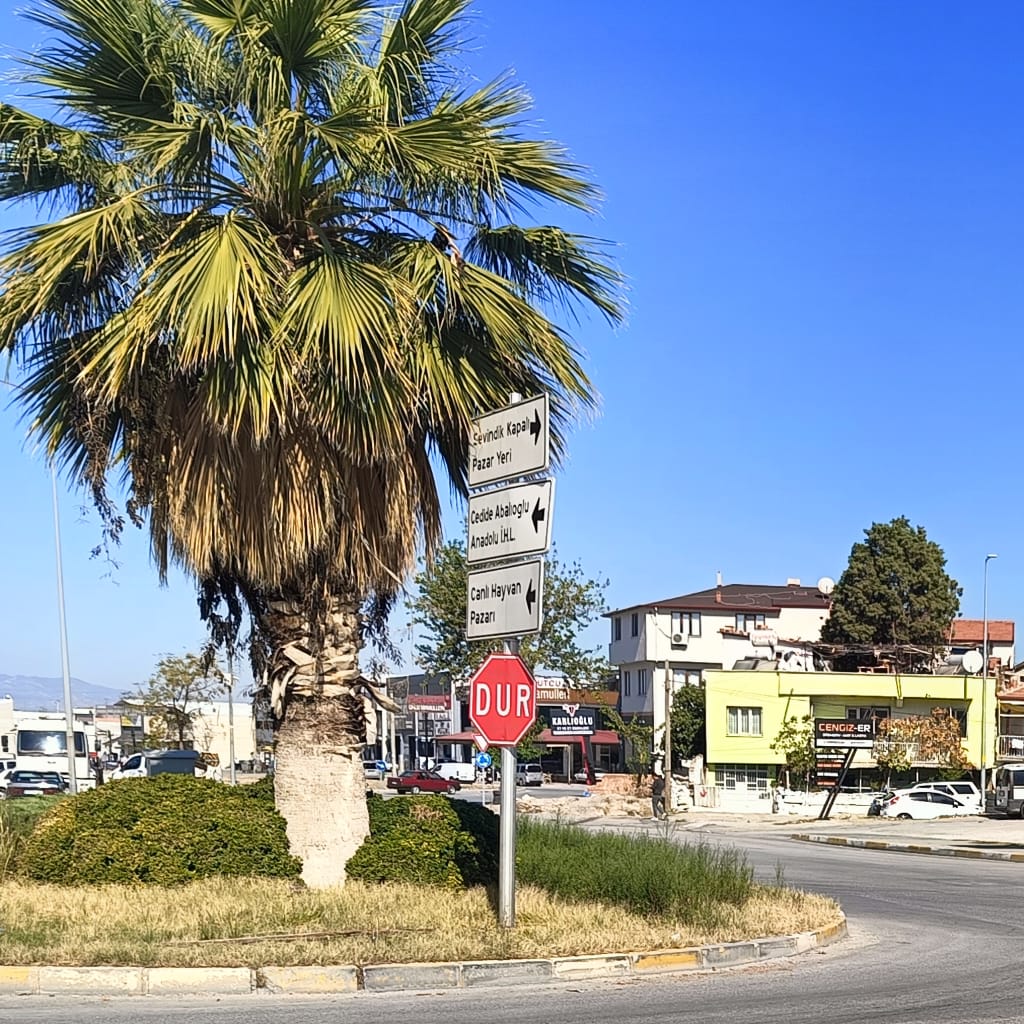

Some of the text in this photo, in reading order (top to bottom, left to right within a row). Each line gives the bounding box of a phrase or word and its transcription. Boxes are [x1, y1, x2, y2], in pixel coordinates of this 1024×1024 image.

[473, 417, 530, 446] Sevindik Kapalı
[472, 448, 512, 472] Pazar Yeri
[471, 509, 494, 525] Cedide
[470, 532, 499, 549] Anadolu
[470, 581, 522, 602] Canlı Hayvan
[470, 610, 496, 625] Pazarı
[475, 683, 531, 718] DUR
